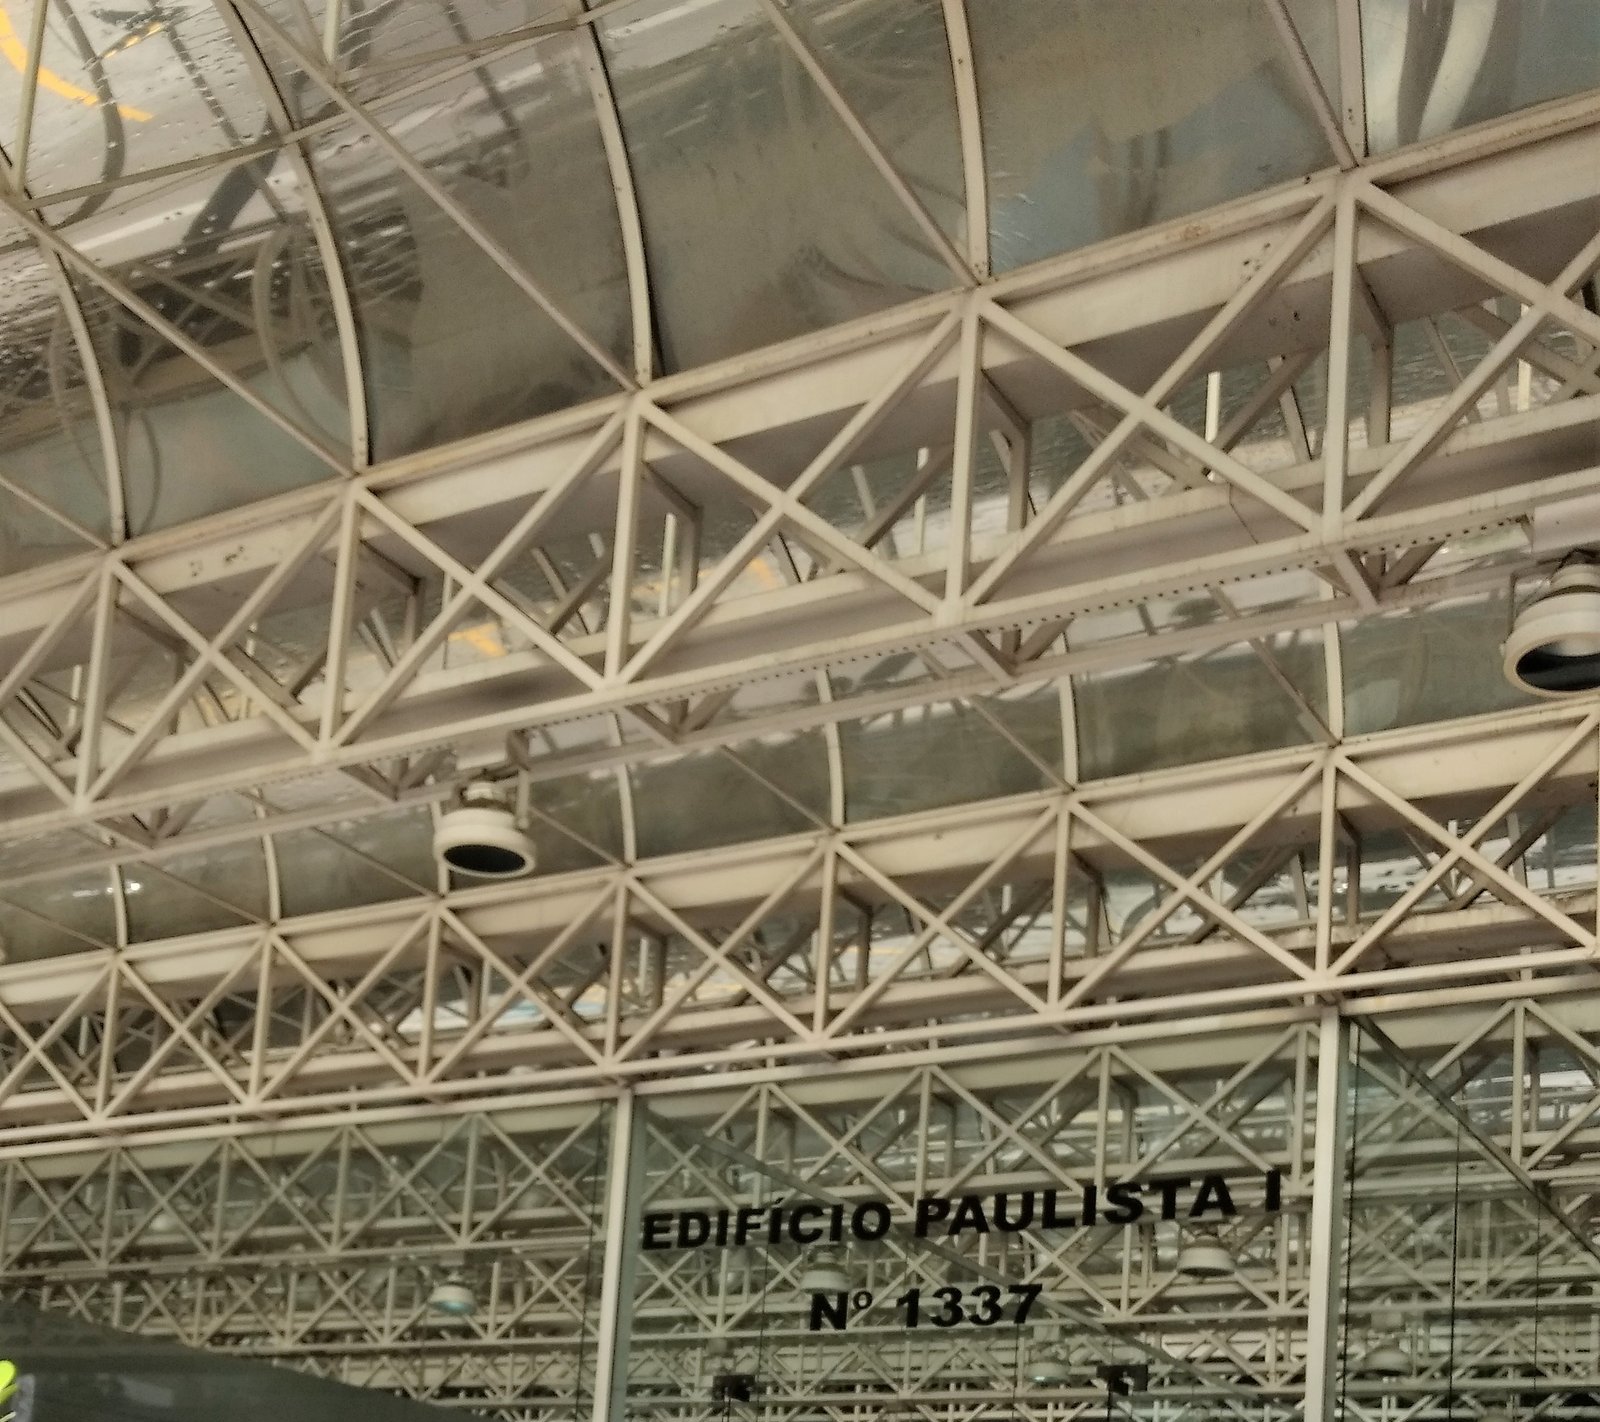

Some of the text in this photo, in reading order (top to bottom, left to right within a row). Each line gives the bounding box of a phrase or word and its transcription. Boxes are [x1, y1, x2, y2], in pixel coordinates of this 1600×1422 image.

[642, 1171, 1281, 1250] EDIFÍCIO PAULISTA I
[896, 1284, 1043, 1329] 1337
